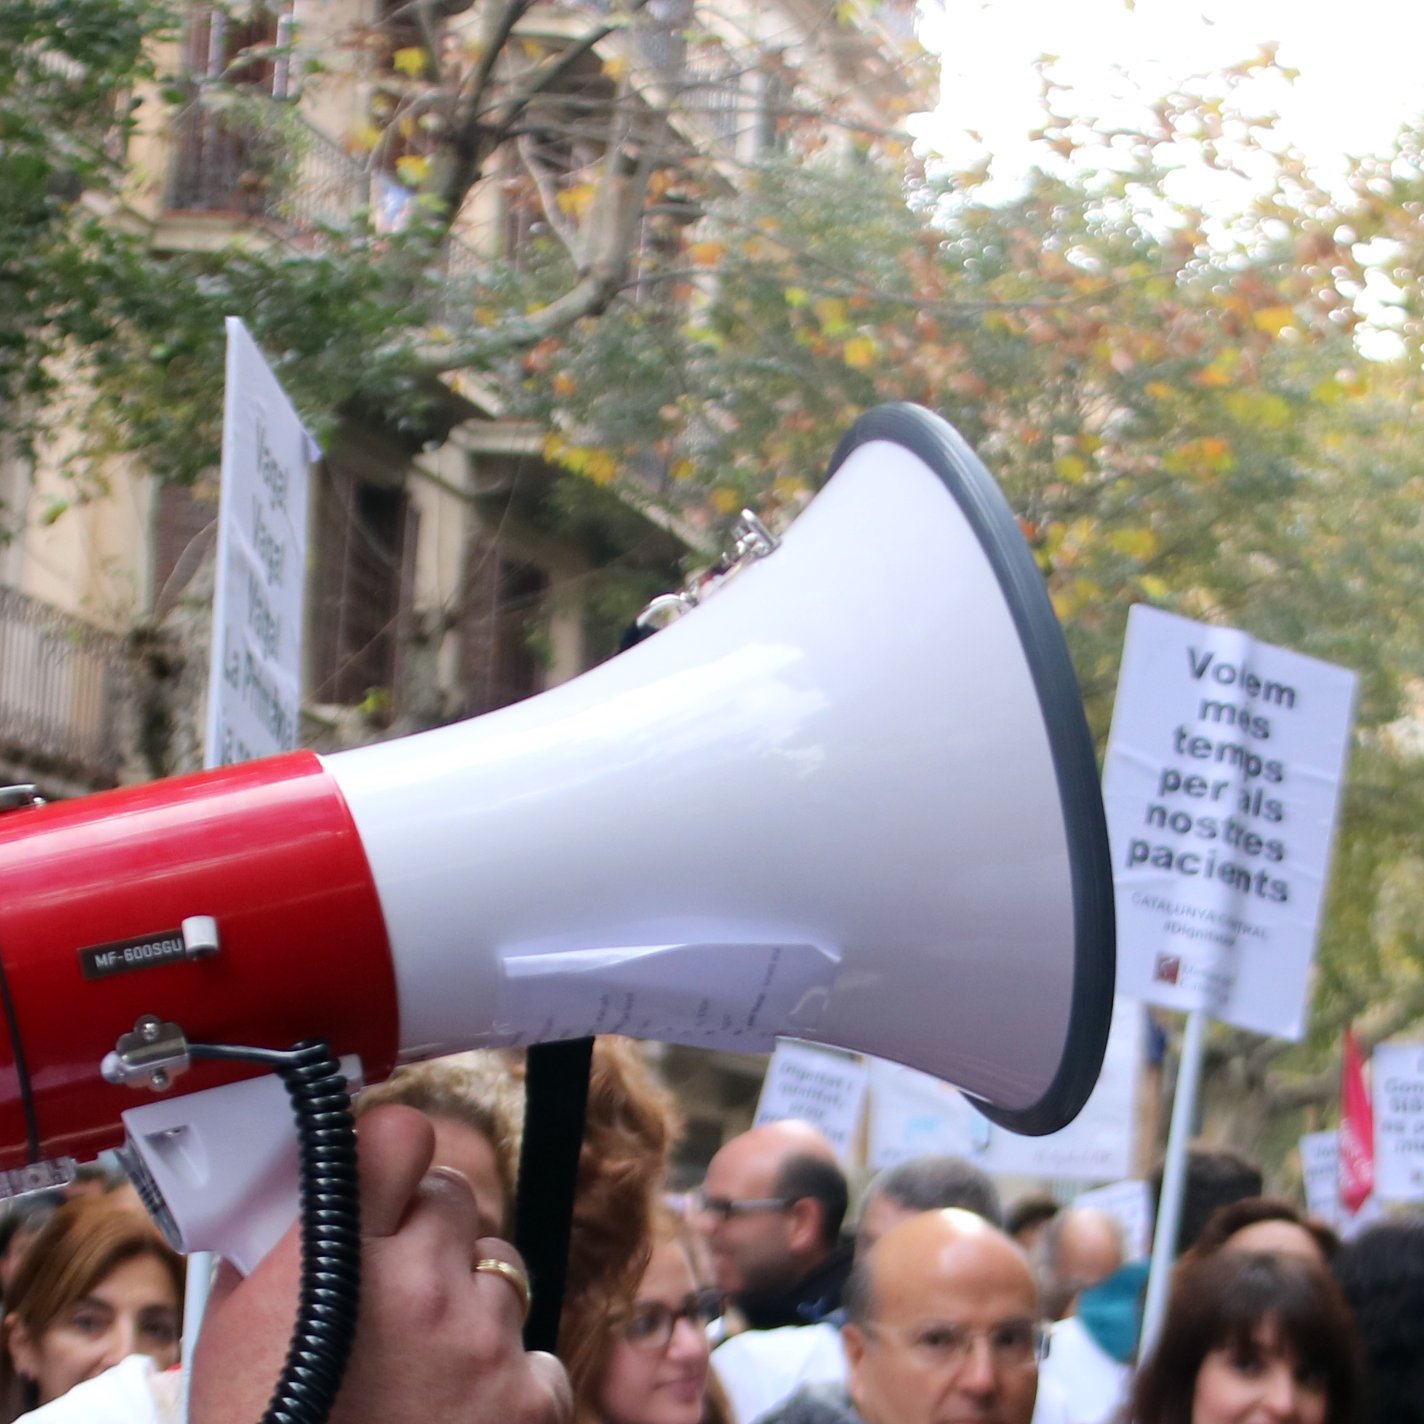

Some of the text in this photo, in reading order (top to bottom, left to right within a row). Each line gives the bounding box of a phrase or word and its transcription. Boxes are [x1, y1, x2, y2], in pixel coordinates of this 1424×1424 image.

[1186, 645, 1297, 710] Volem
[1174, 724, 1284, 783] temps
[1159, 767, 1230, 802] per
[1145, 803, 1285, 863] nostres
[1126, 836, 1290, 903] pacients
